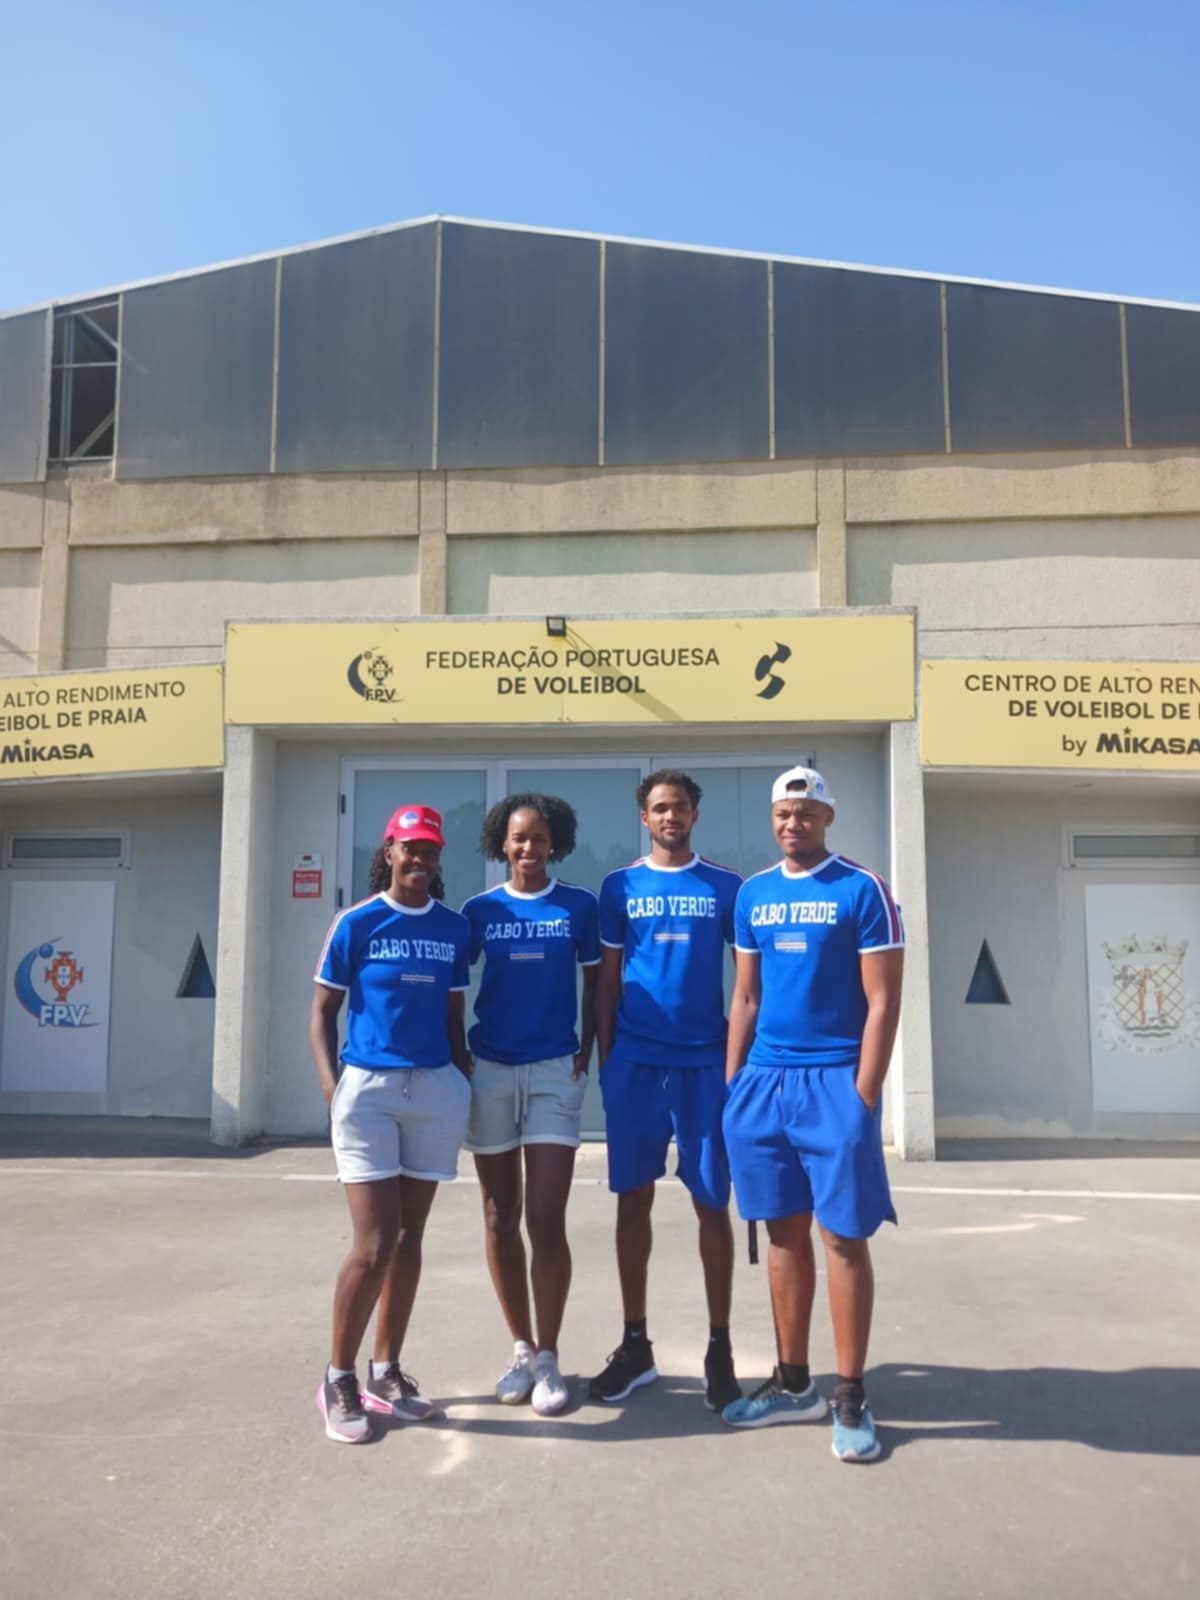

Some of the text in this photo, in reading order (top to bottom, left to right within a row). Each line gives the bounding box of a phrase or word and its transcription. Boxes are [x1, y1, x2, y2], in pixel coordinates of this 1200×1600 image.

[426, 645, 720, 672] FEDERAÇÃO PORTUGUESA
[3, 681, 185, 708] ALTO RENDIMENTO
[497, 675, 646, 695] DE VOLEIBOL
[964, 674, 1057, 692] CENTRO
[1063, 675, 1092, 693] DE
[1098, 676, 1153, 694] ALTO
[57, 711, 82, 728] DE
[88, 706, 147, 726] PRAIA
[1008, 700, 1038, 717] DE
[1044, 700, 1154, 720] VOLEIBOL
[1161, 702, 1191, 720] DE
[1062, 734, 1087, 757] by
[626, 896, 716, 918] CABO VERDE
[751, 901, 838, 927] CABO VERDE
[485, 919, 571, 941] CABO VERDE
[369, 940, 456, 963] CABO VERDE
[39, 1004, 89, 1027] FPV
